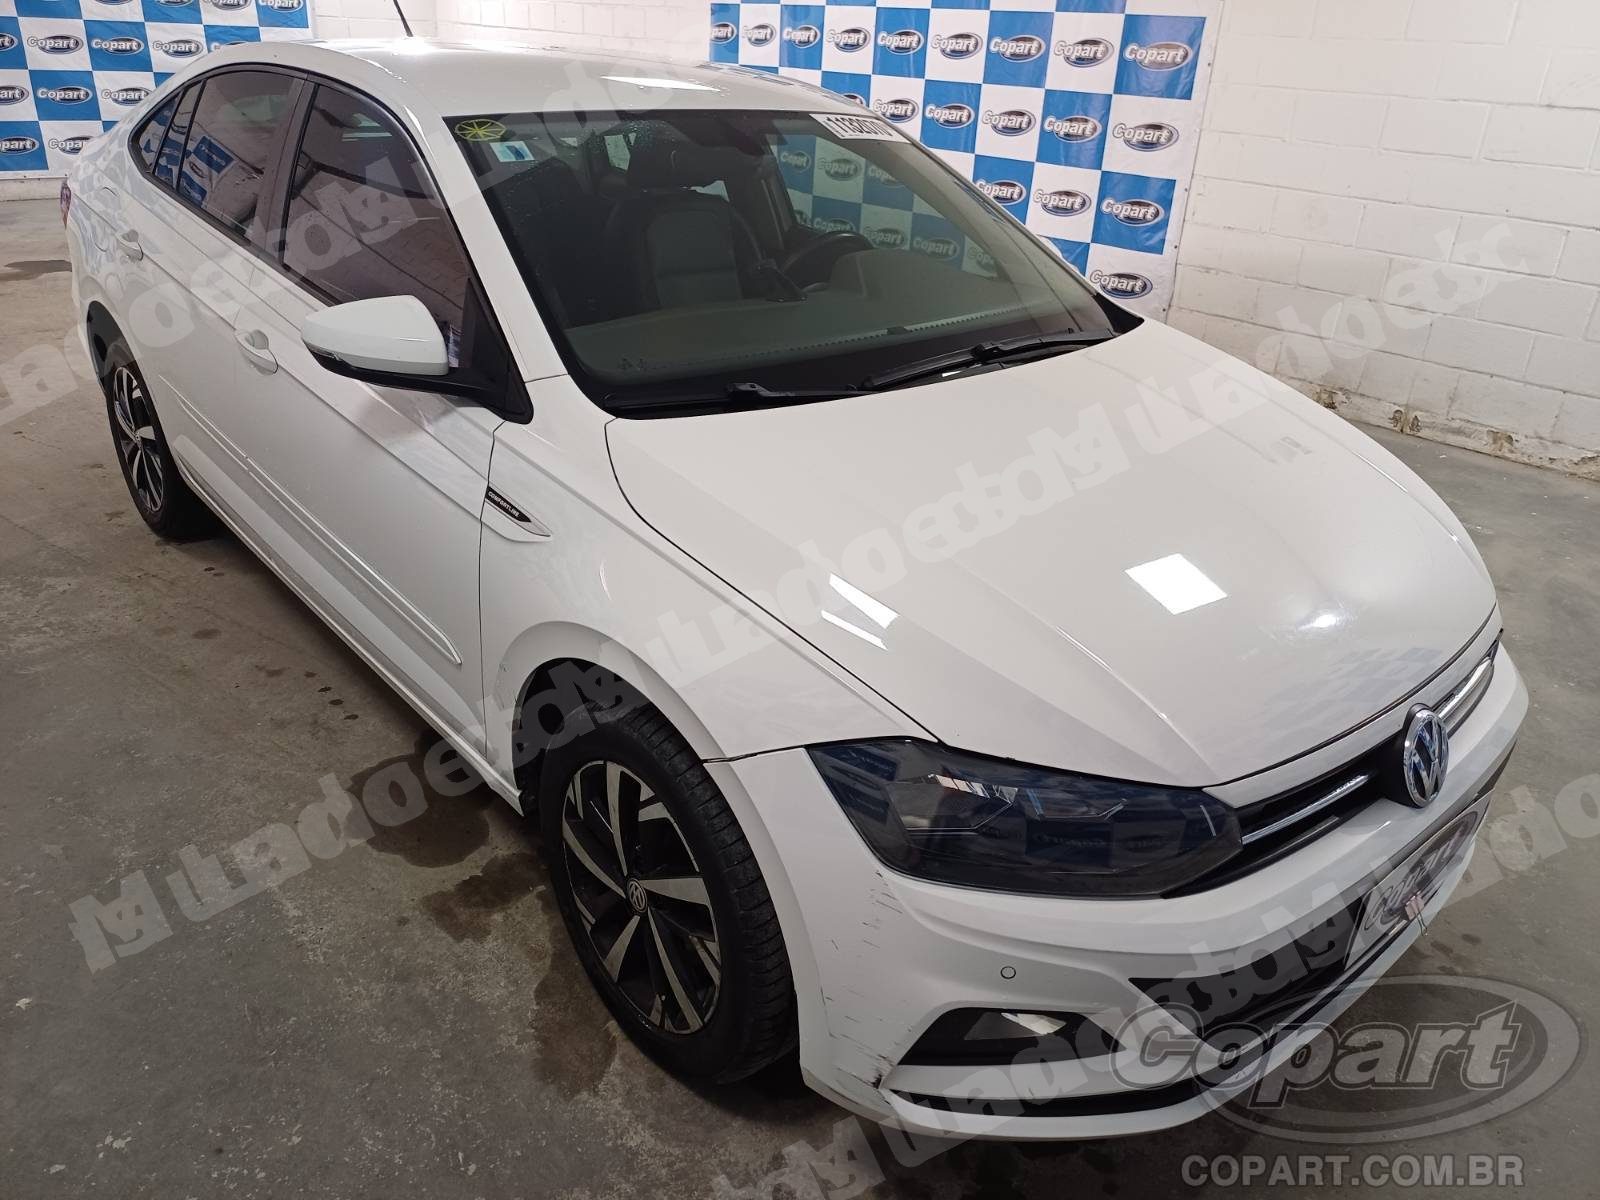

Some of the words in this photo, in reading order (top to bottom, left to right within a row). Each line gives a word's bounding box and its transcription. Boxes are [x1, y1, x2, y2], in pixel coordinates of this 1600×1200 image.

[27, 35, 77, 50] Copart
[91, 39, 139, 51] Copart
[152, 41, 198, 54] Copart
[826, 28, 865, 46] Copart
[877, 31, 919, 52] Copart
[931, 34, 977, 55] Copart
[989, 37, 1039, 58] Copart
[1054, 40, 1106, 61] Copart
[1125, 44, 1185, 65] Copart
[36, 88, 87, 101] Copart
[102, 89, 148, 102] Copart
[872, 99, 913, 119] Copart
[925, 106, 969, 127] Copart
[982, 110, 1030, 132] Copart
[1044, 116, 1093, 140] Copart
[0, 138, 33, 151] part
[1113, 122, 1171, 147] Copart
[975, 179, 1020, 202] Copart
[1034, 189, 1082, 212] Copart
[1101, 198, 1157, 222] Copart
[913, 237, 955, 256] Copart
[1091, 270, 1144, 295] Copart
